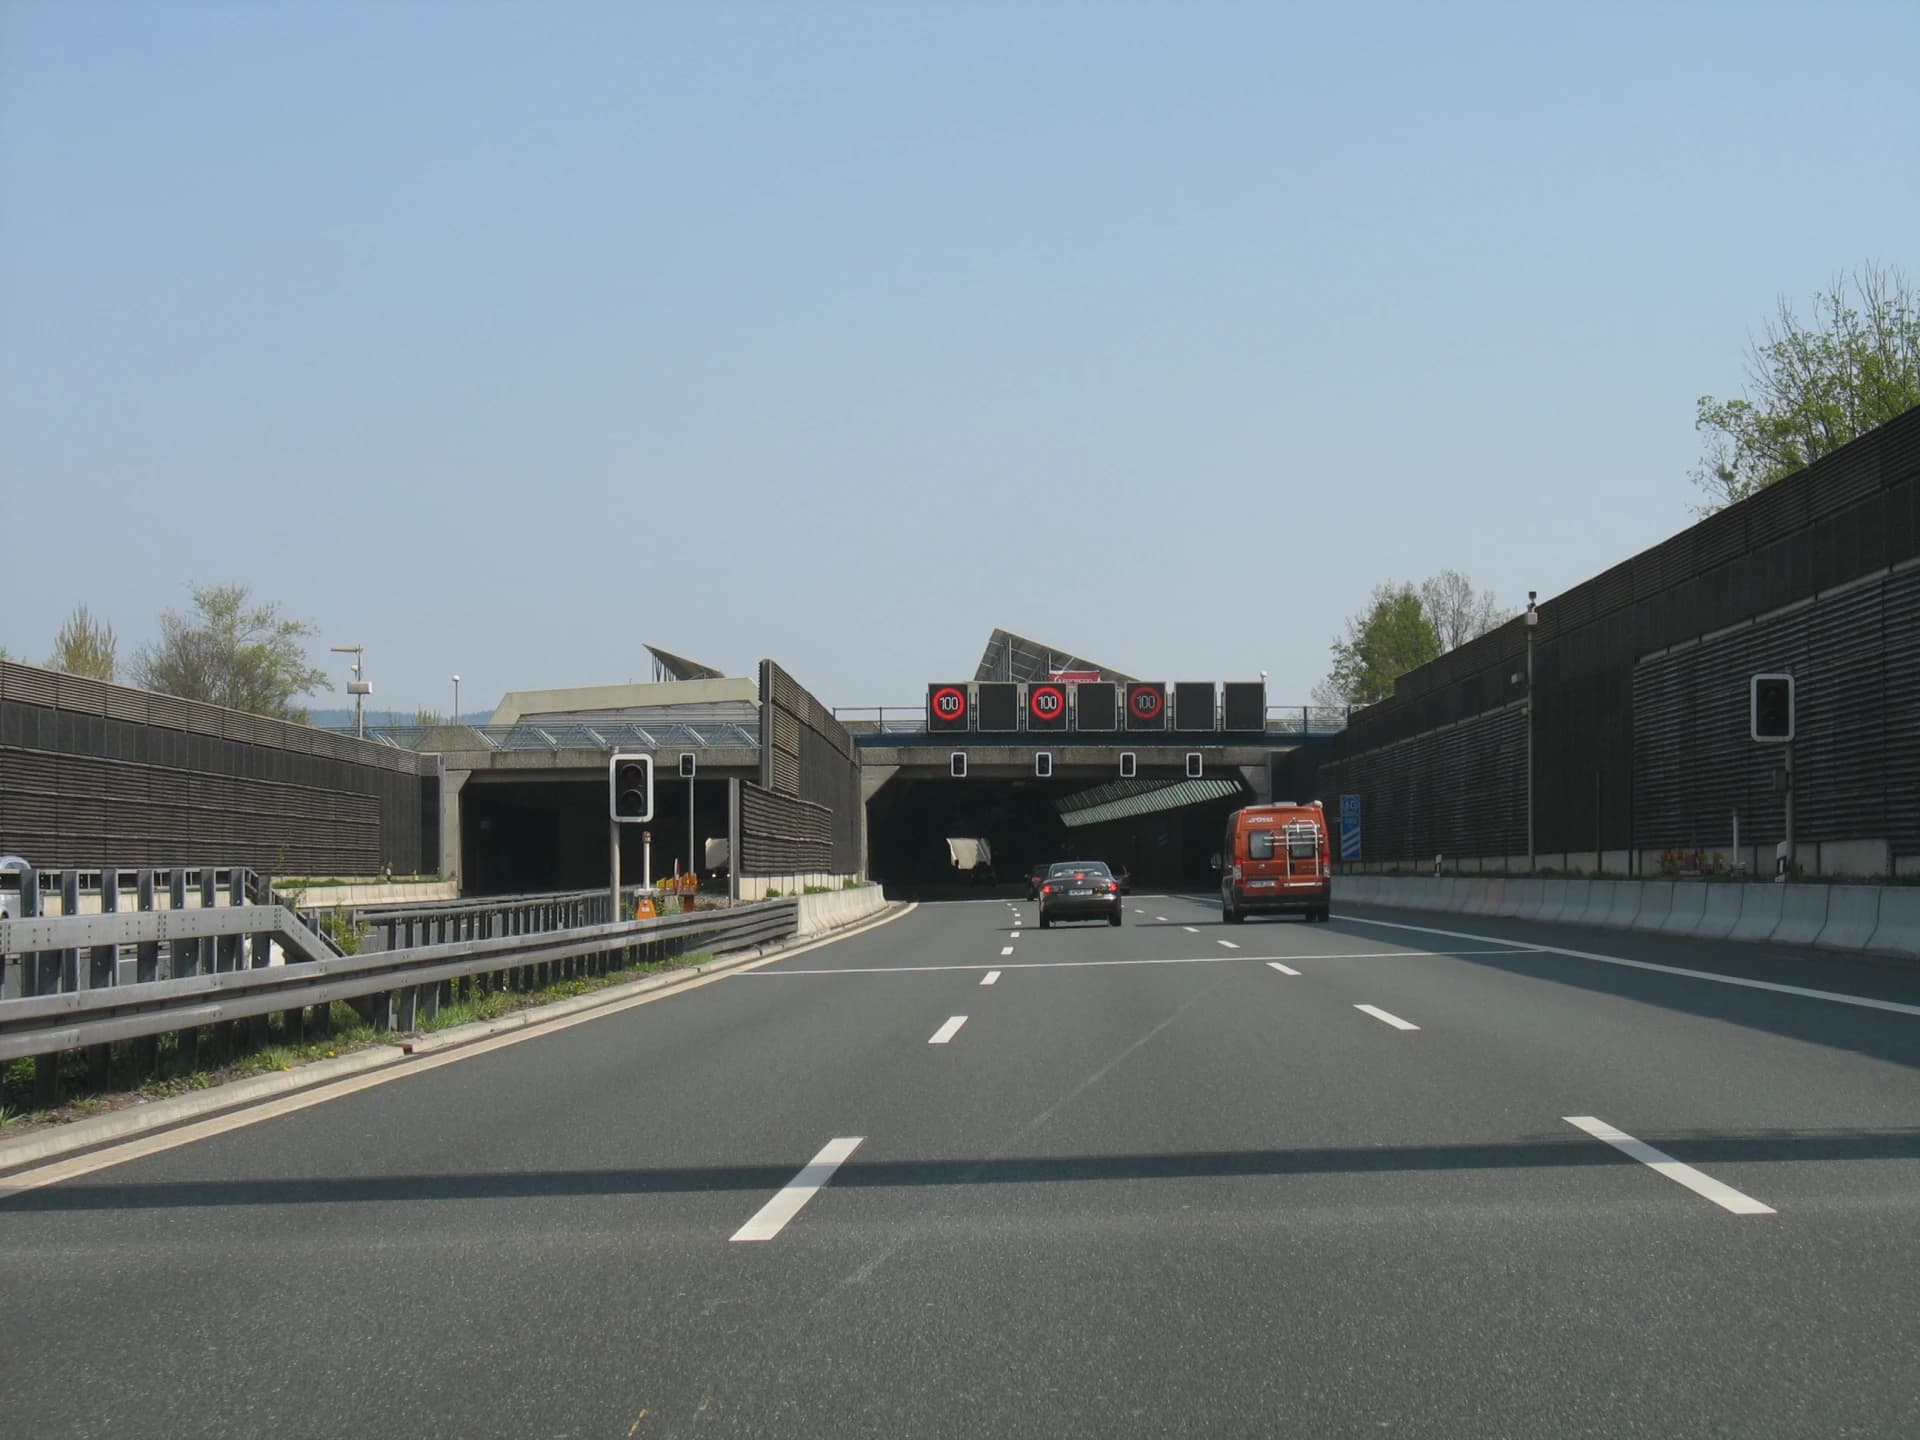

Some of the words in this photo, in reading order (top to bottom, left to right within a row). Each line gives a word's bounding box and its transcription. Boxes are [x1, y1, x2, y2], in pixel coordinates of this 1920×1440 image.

[939, 696, 959, 711] 100
[1037, 695, 1057, 710] 100
[1136, 695, 1156, 710] 100
